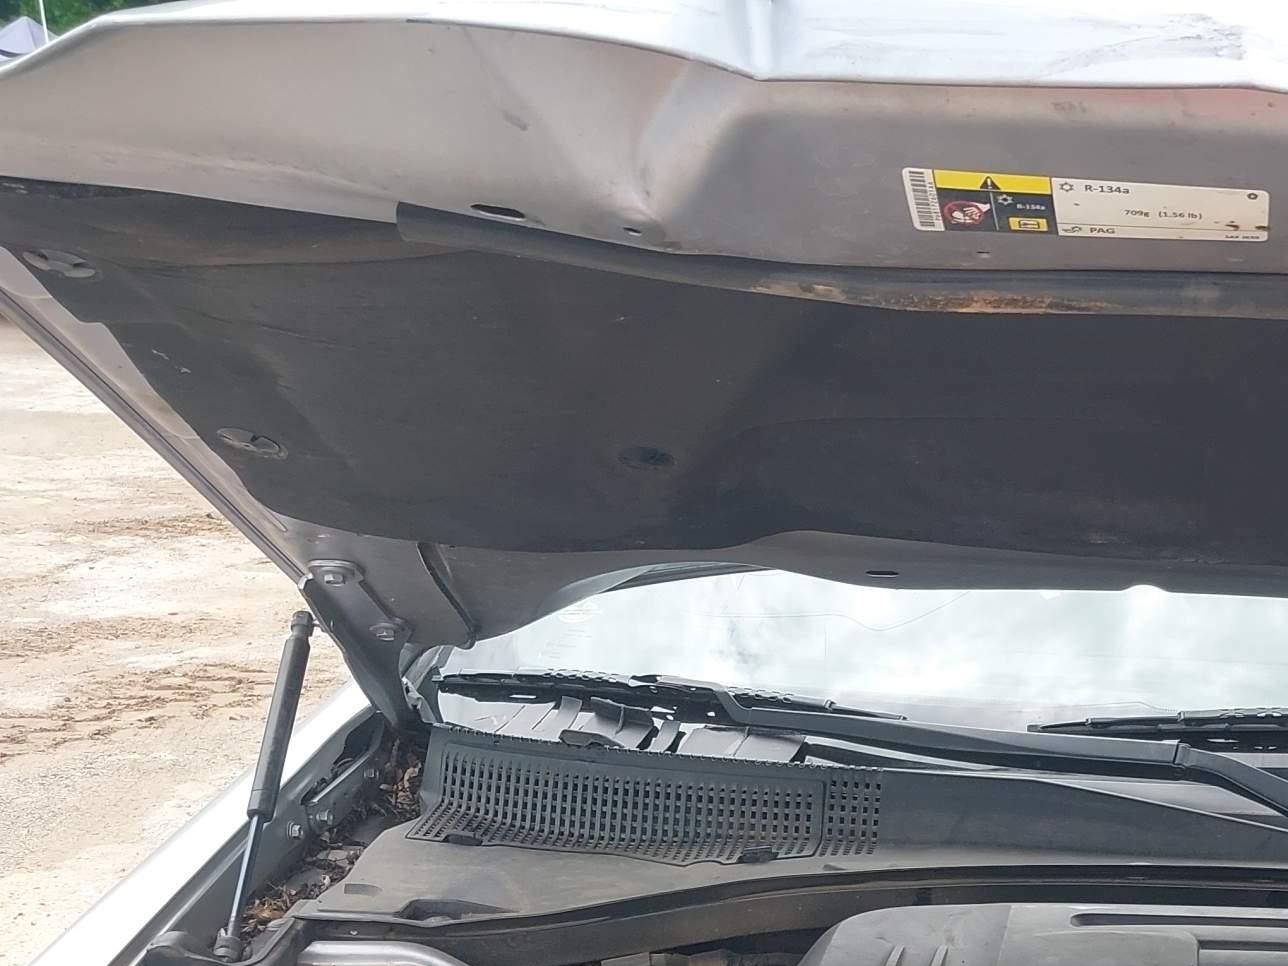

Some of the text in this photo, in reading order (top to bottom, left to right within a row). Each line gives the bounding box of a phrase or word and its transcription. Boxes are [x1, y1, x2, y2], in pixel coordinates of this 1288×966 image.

[1084, 184, 1130, 195] R-134a
[1124, 209, 1203, 220] 709g (1.56 lb)
[1089, 226, 1115, 235] PAG
